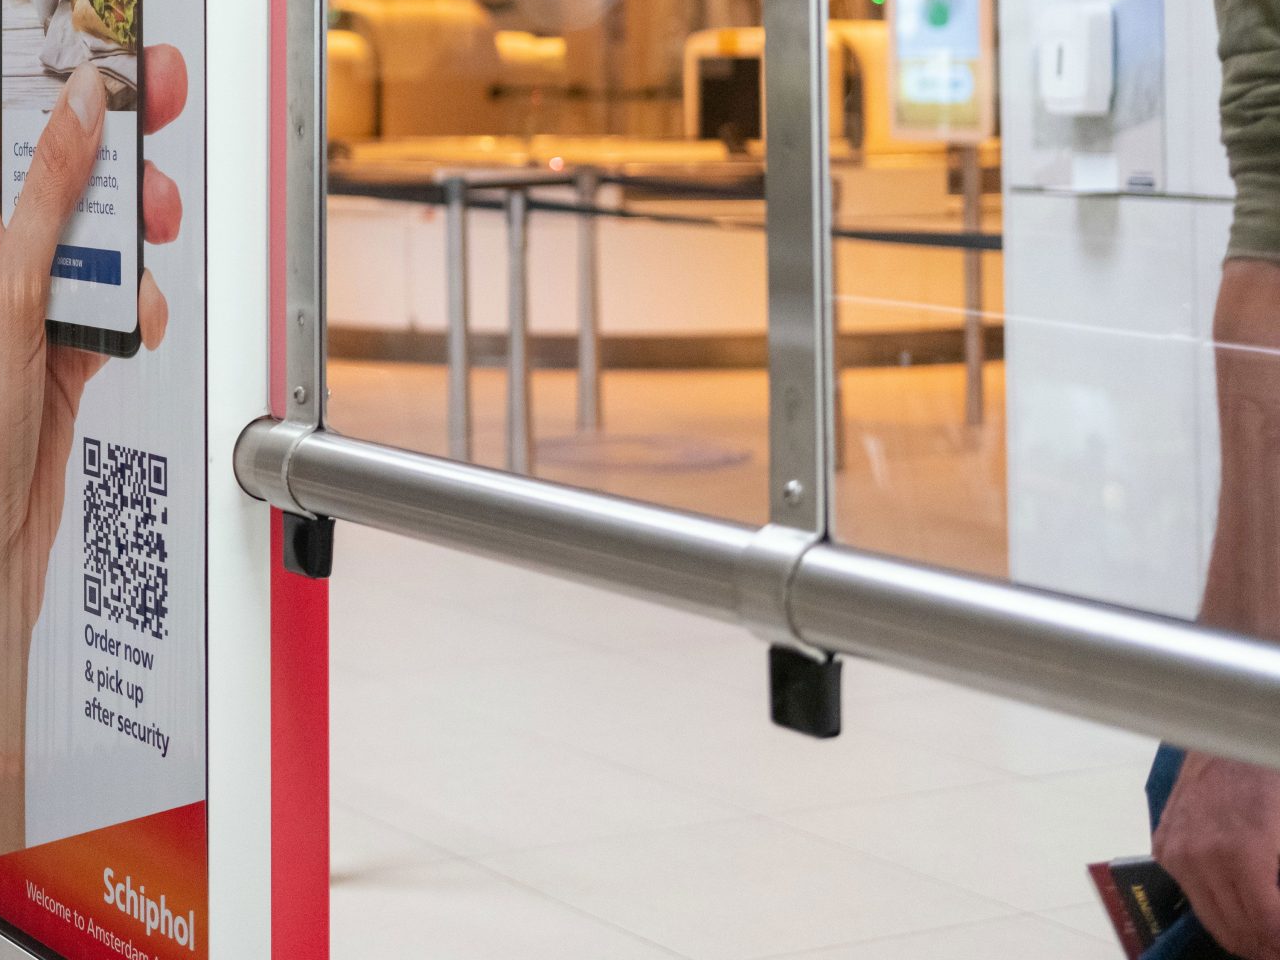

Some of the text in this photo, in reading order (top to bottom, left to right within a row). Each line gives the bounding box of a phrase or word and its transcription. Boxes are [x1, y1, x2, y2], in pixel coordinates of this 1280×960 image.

[112, 149, 118, 161] a
[84, 623, 154, 670] Order now
[85, 660, 144, 708] & pick up
[85, 696, 170, 758] after security
[25, 879, 72, 923] Welcome
[73, 910, 85, 931] to
[103, 867, 195, 951] Schiphol
